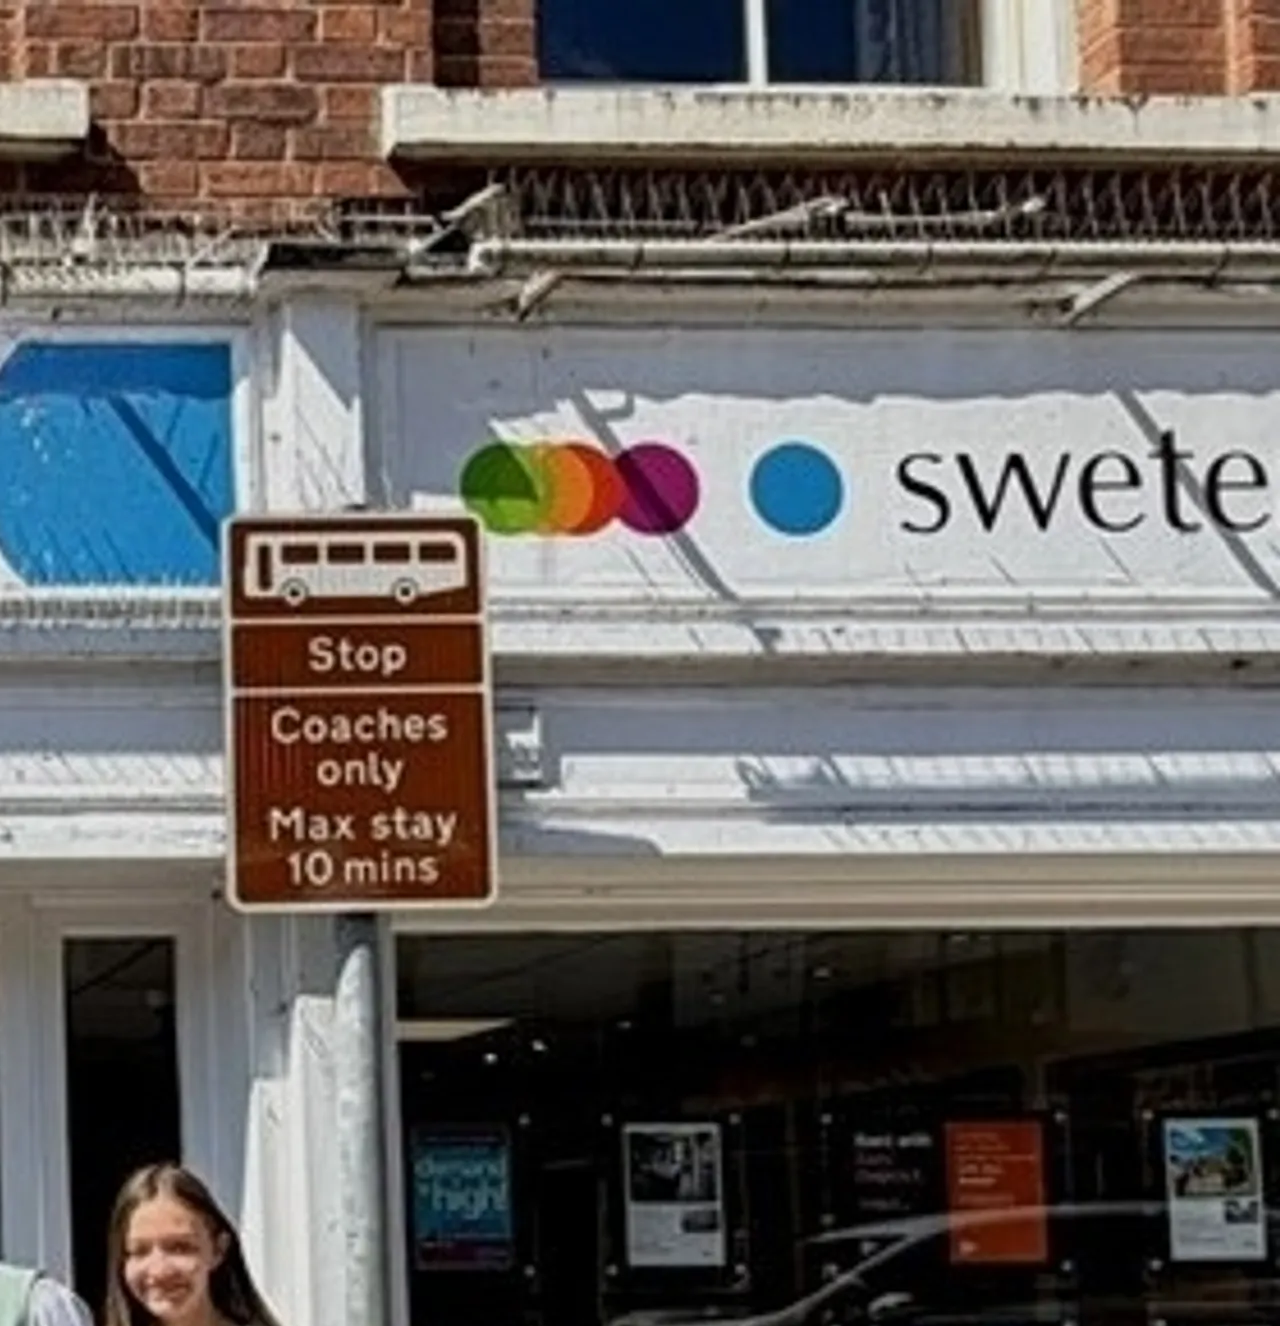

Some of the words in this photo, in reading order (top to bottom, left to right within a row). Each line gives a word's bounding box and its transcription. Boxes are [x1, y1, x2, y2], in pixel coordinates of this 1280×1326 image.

[896, 429, 1272, 534] swete
[308, 635, 407, 675] Stop
[270, 706, 448, 744] Coaches
[316, 752, 403, 791] only
[269, 807, 356, 841] Max
[370, 807, 457, 845] stay
[288, 851, 334, 885] 10
[343, 852, 439, 884] mins
